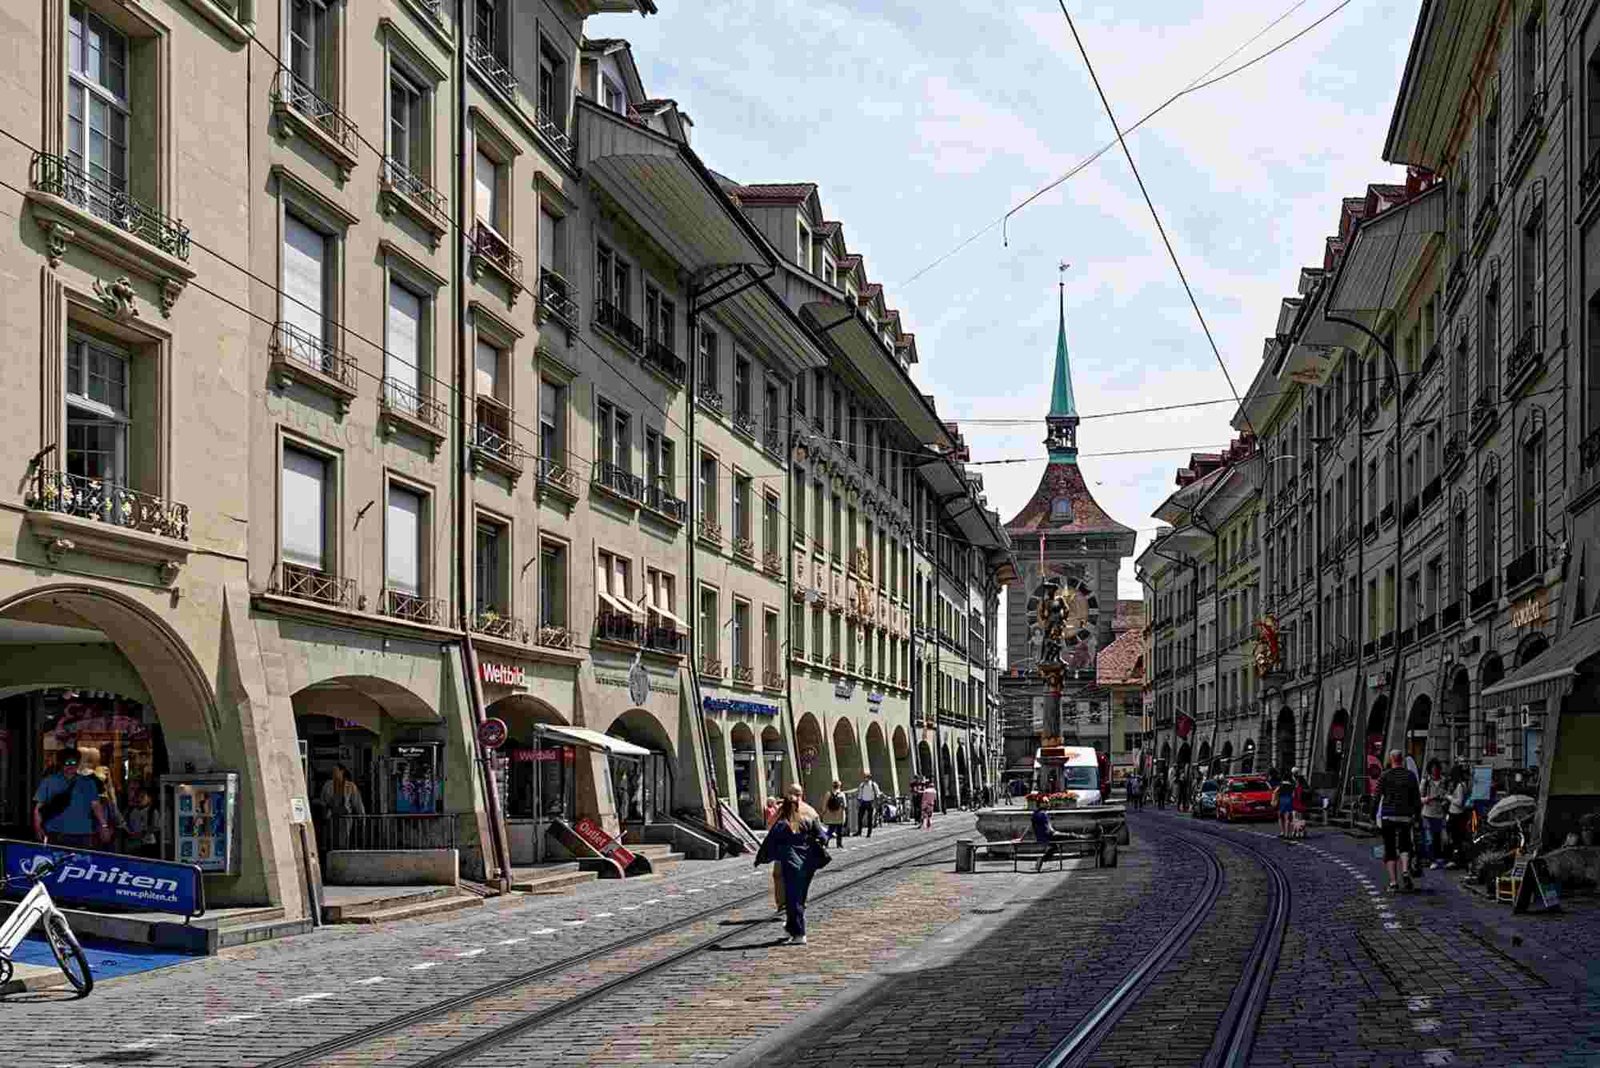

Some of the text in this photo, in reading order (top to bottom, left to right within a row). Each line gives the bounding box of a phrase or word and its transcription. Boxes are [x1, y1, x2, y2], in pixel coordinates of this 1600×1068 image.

[482, 663, 525, 686] Weltbild
[580, 822, 608, 847] Outlet
[57, 864, 178, 892] phiten
[115, 888, 178, 902] www.phiten.ch
